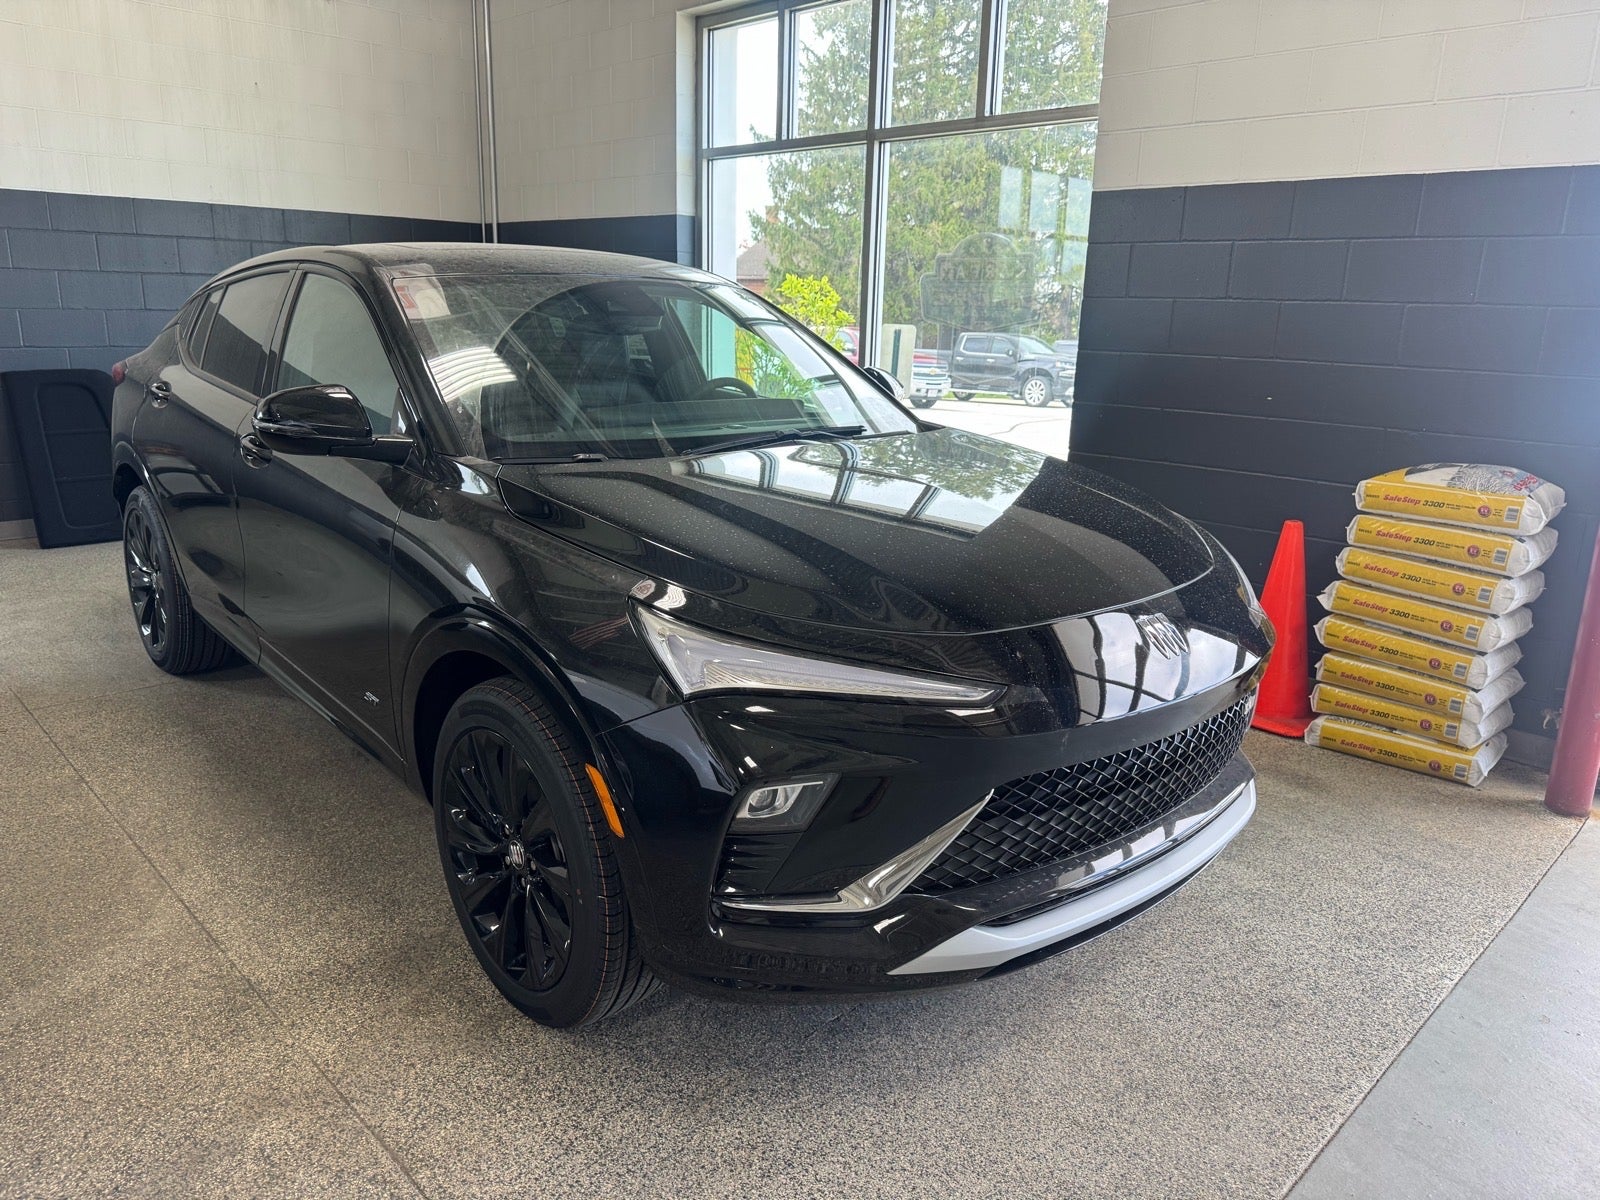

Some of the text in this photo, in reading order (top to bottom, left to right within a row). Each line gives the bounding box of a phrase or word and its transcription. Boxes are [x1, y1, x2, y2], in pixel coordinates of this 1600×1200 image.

[1422, 499, 1446, 509] 3300
[1413, 537, 1436, 546] 3300
[1400, 572, 1422, 583] 3300
[1389, 608, 1411, 619] 3300
[1378, 645, 1399, 656] 3300
[1375, 681, 1395, 692] 3300
[1369, 709, 1390, 719] 3300
[1377, 748, 1398, 758] 3300
